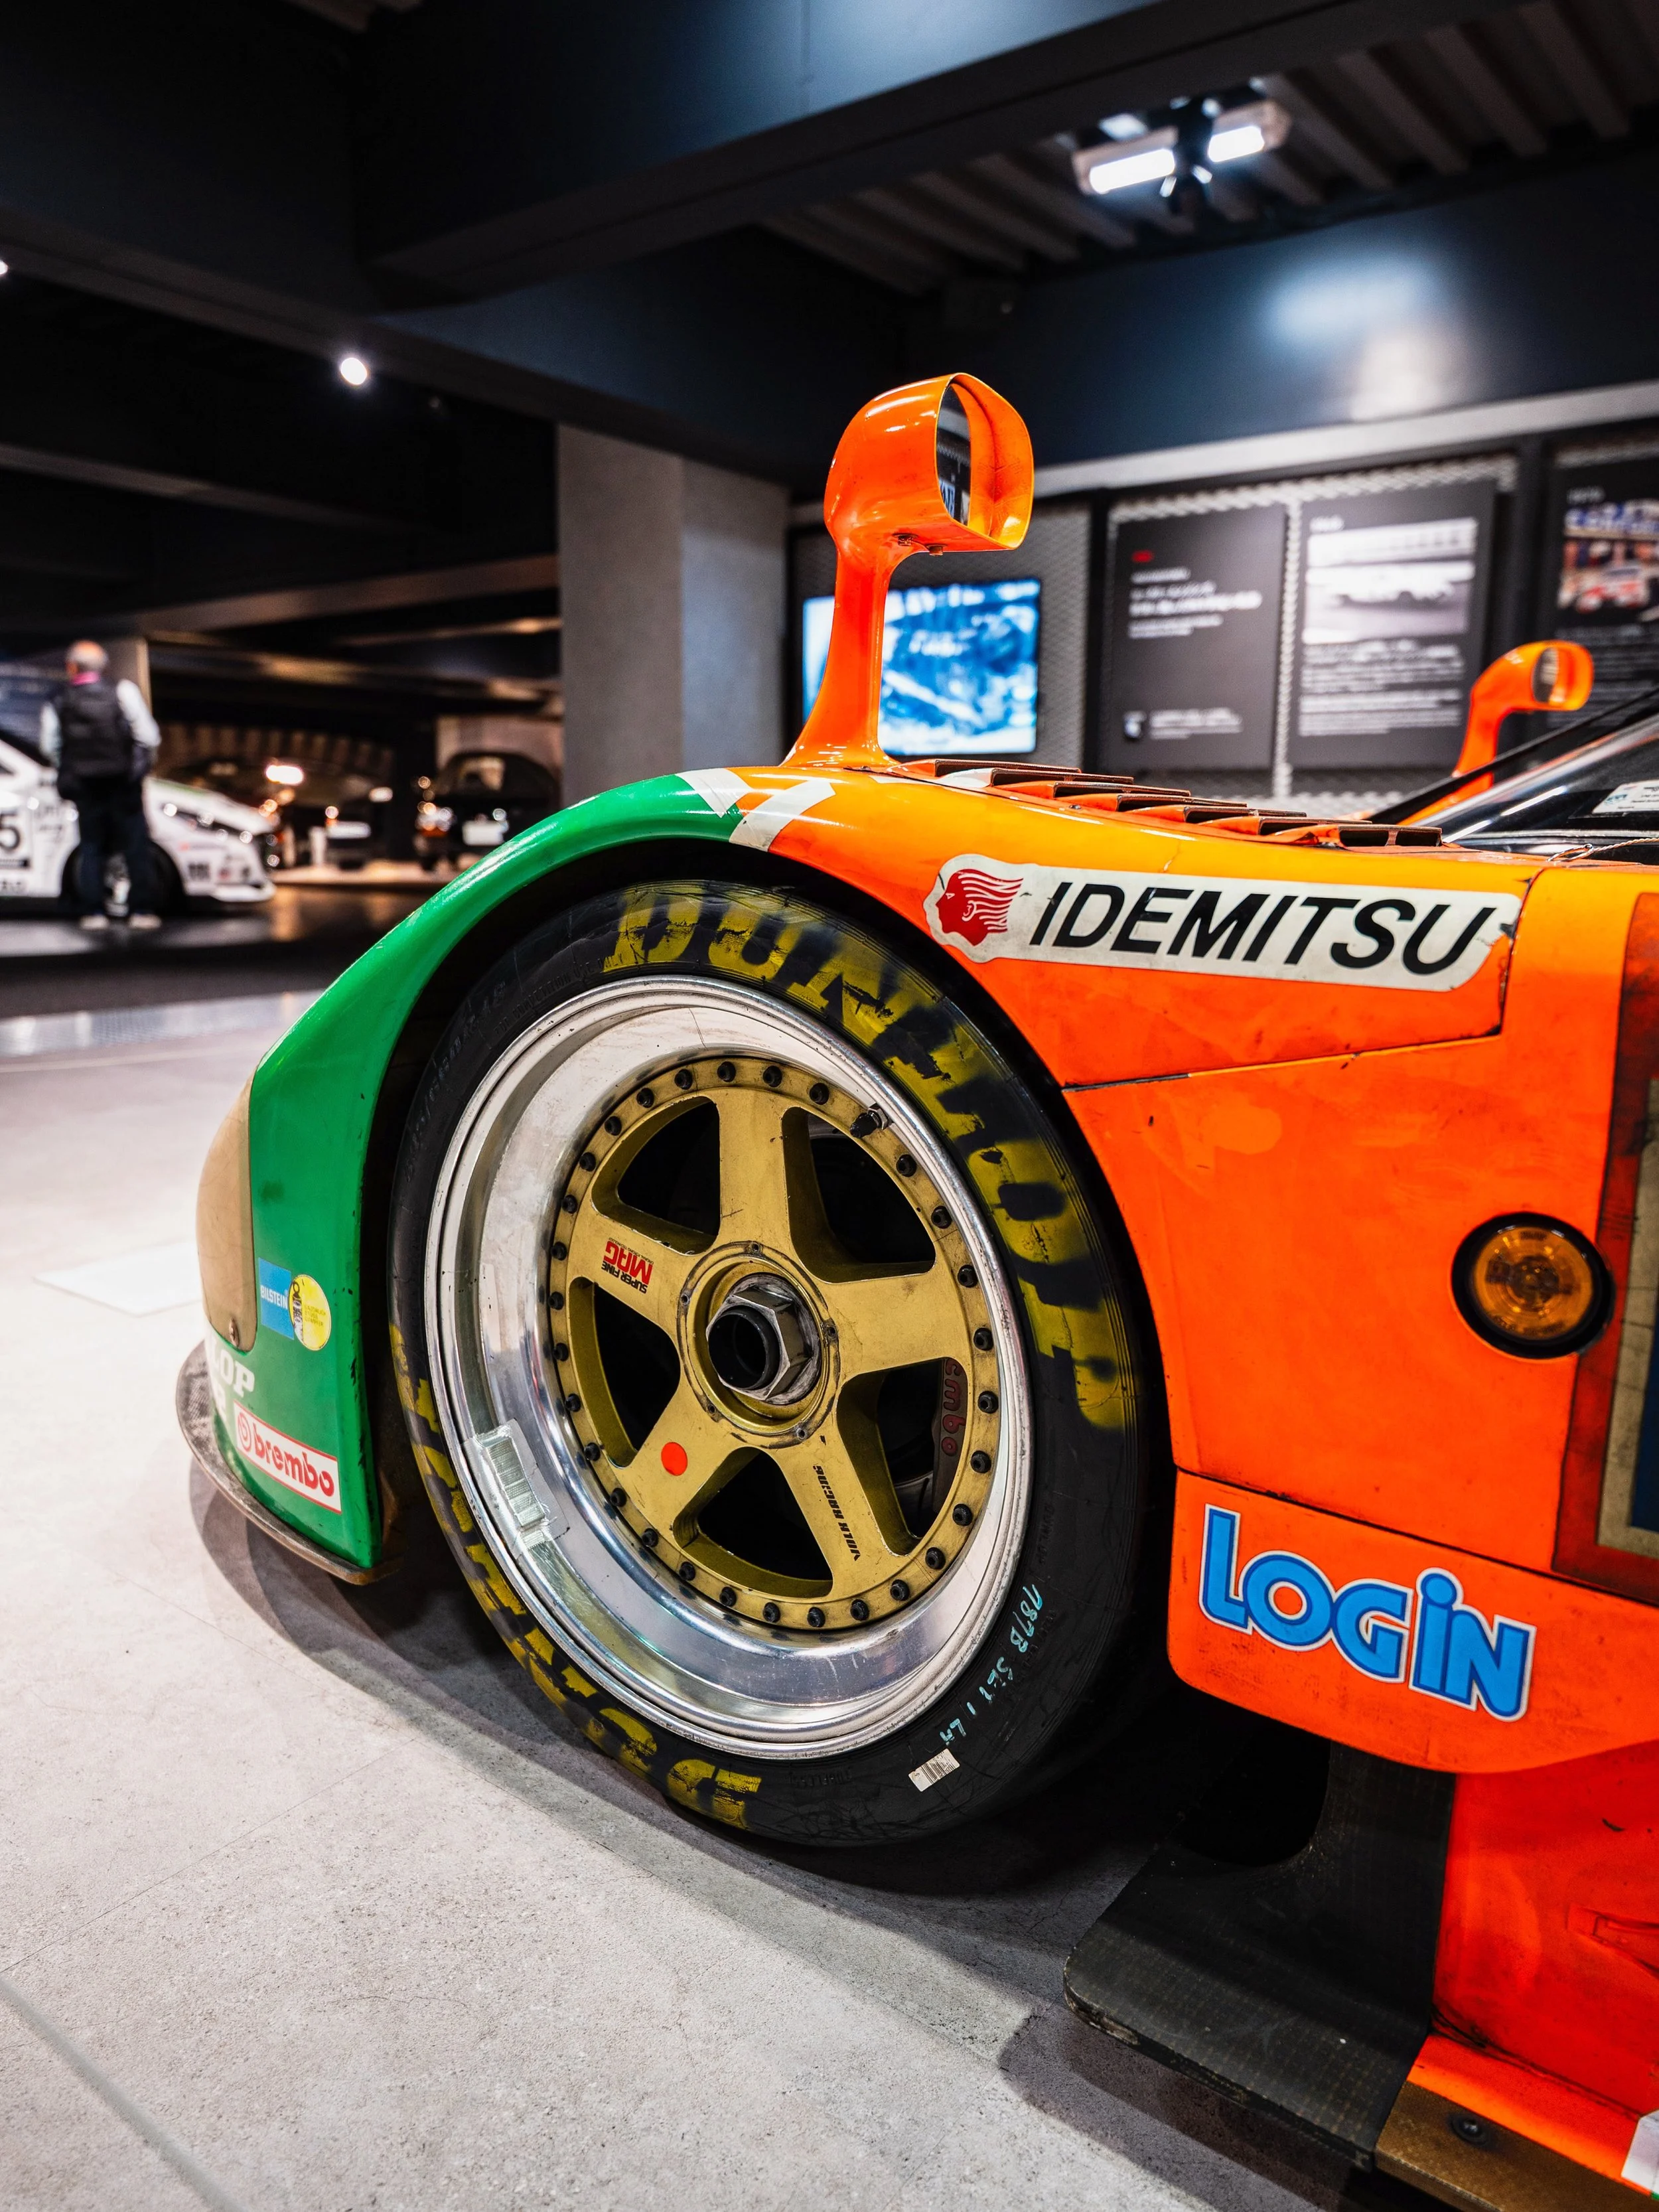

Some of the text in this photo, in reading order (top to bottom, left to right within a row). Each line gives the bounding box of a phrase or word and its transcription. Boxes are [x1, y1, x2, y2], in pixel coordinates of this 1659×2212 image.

[1029, 881, 1497, 975] IDEMITSU
[600, 883, 1129, 1430] DUNLOP
[260, 1284, 289, 1310] BILSTEIN
[601, 1260, 648, 1294] SUPER FINE
[603, 1240, 654, 1286] MAG
[253, 1422, 335, 1497] brembo
[813, 1465, 861, 1562] VOLK RACING
[1010, 1584, 1043, 1653] 787B
